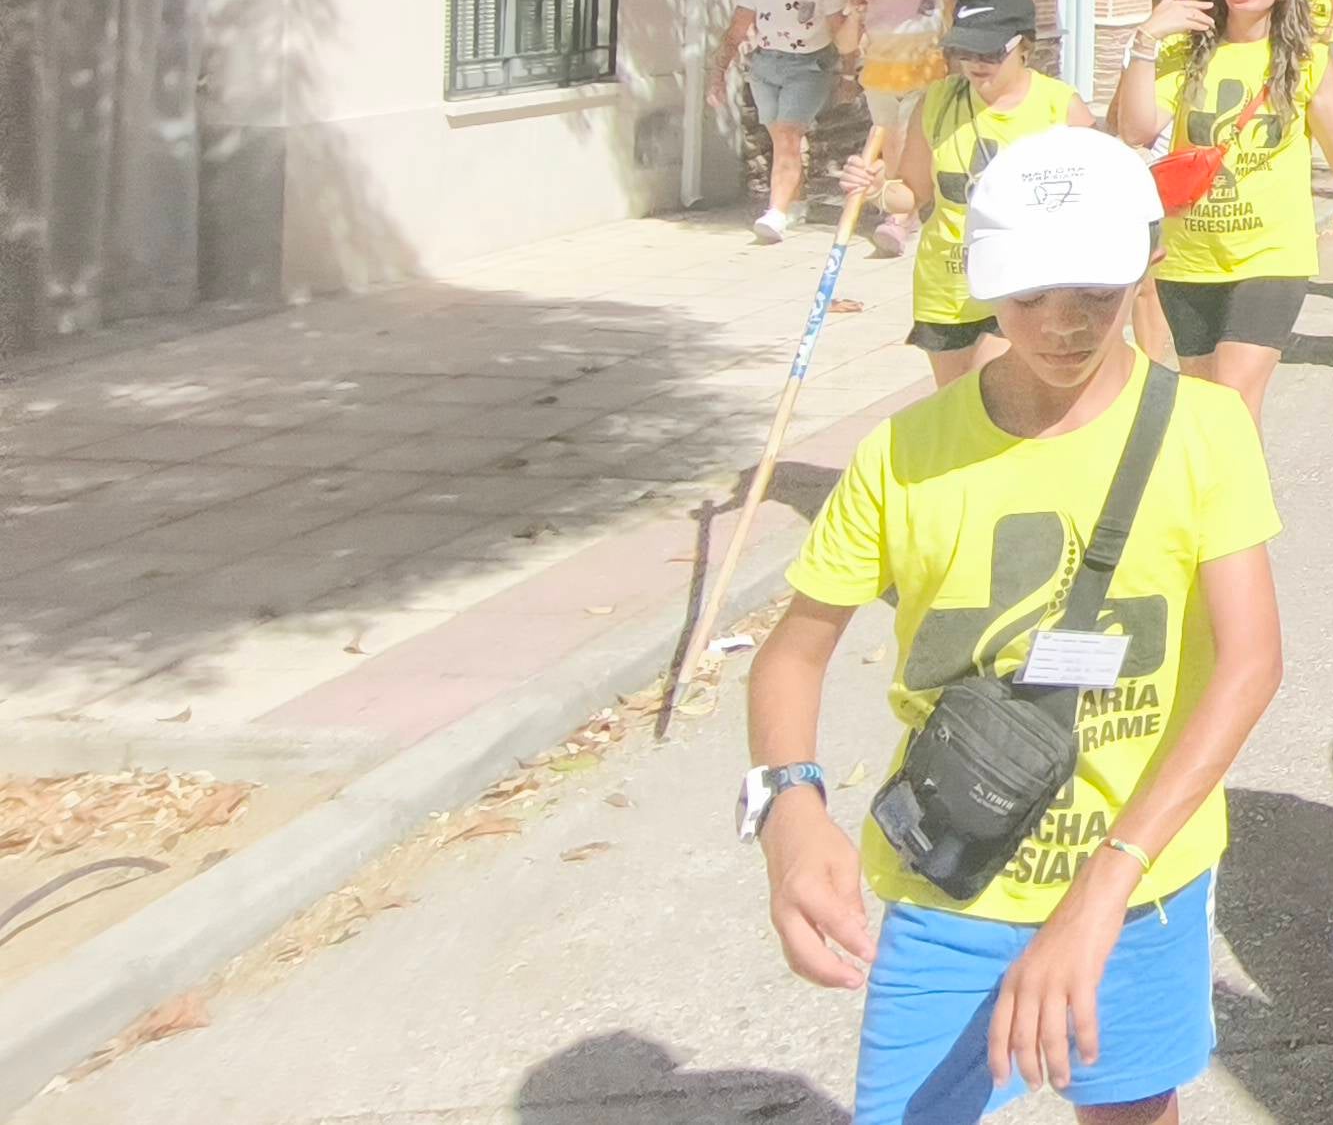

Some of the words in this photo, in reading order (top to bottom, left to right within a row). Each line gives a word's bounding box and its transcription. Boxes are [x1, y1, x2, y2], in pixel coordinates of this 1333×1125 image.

[1190, 202, 1255, 218] MARCHA
[1184, 216, 1264, 234] TERESIANA
[1078, 680, 1160, 723] ARÍA
[1039, 811, 1108, 846] CHA
